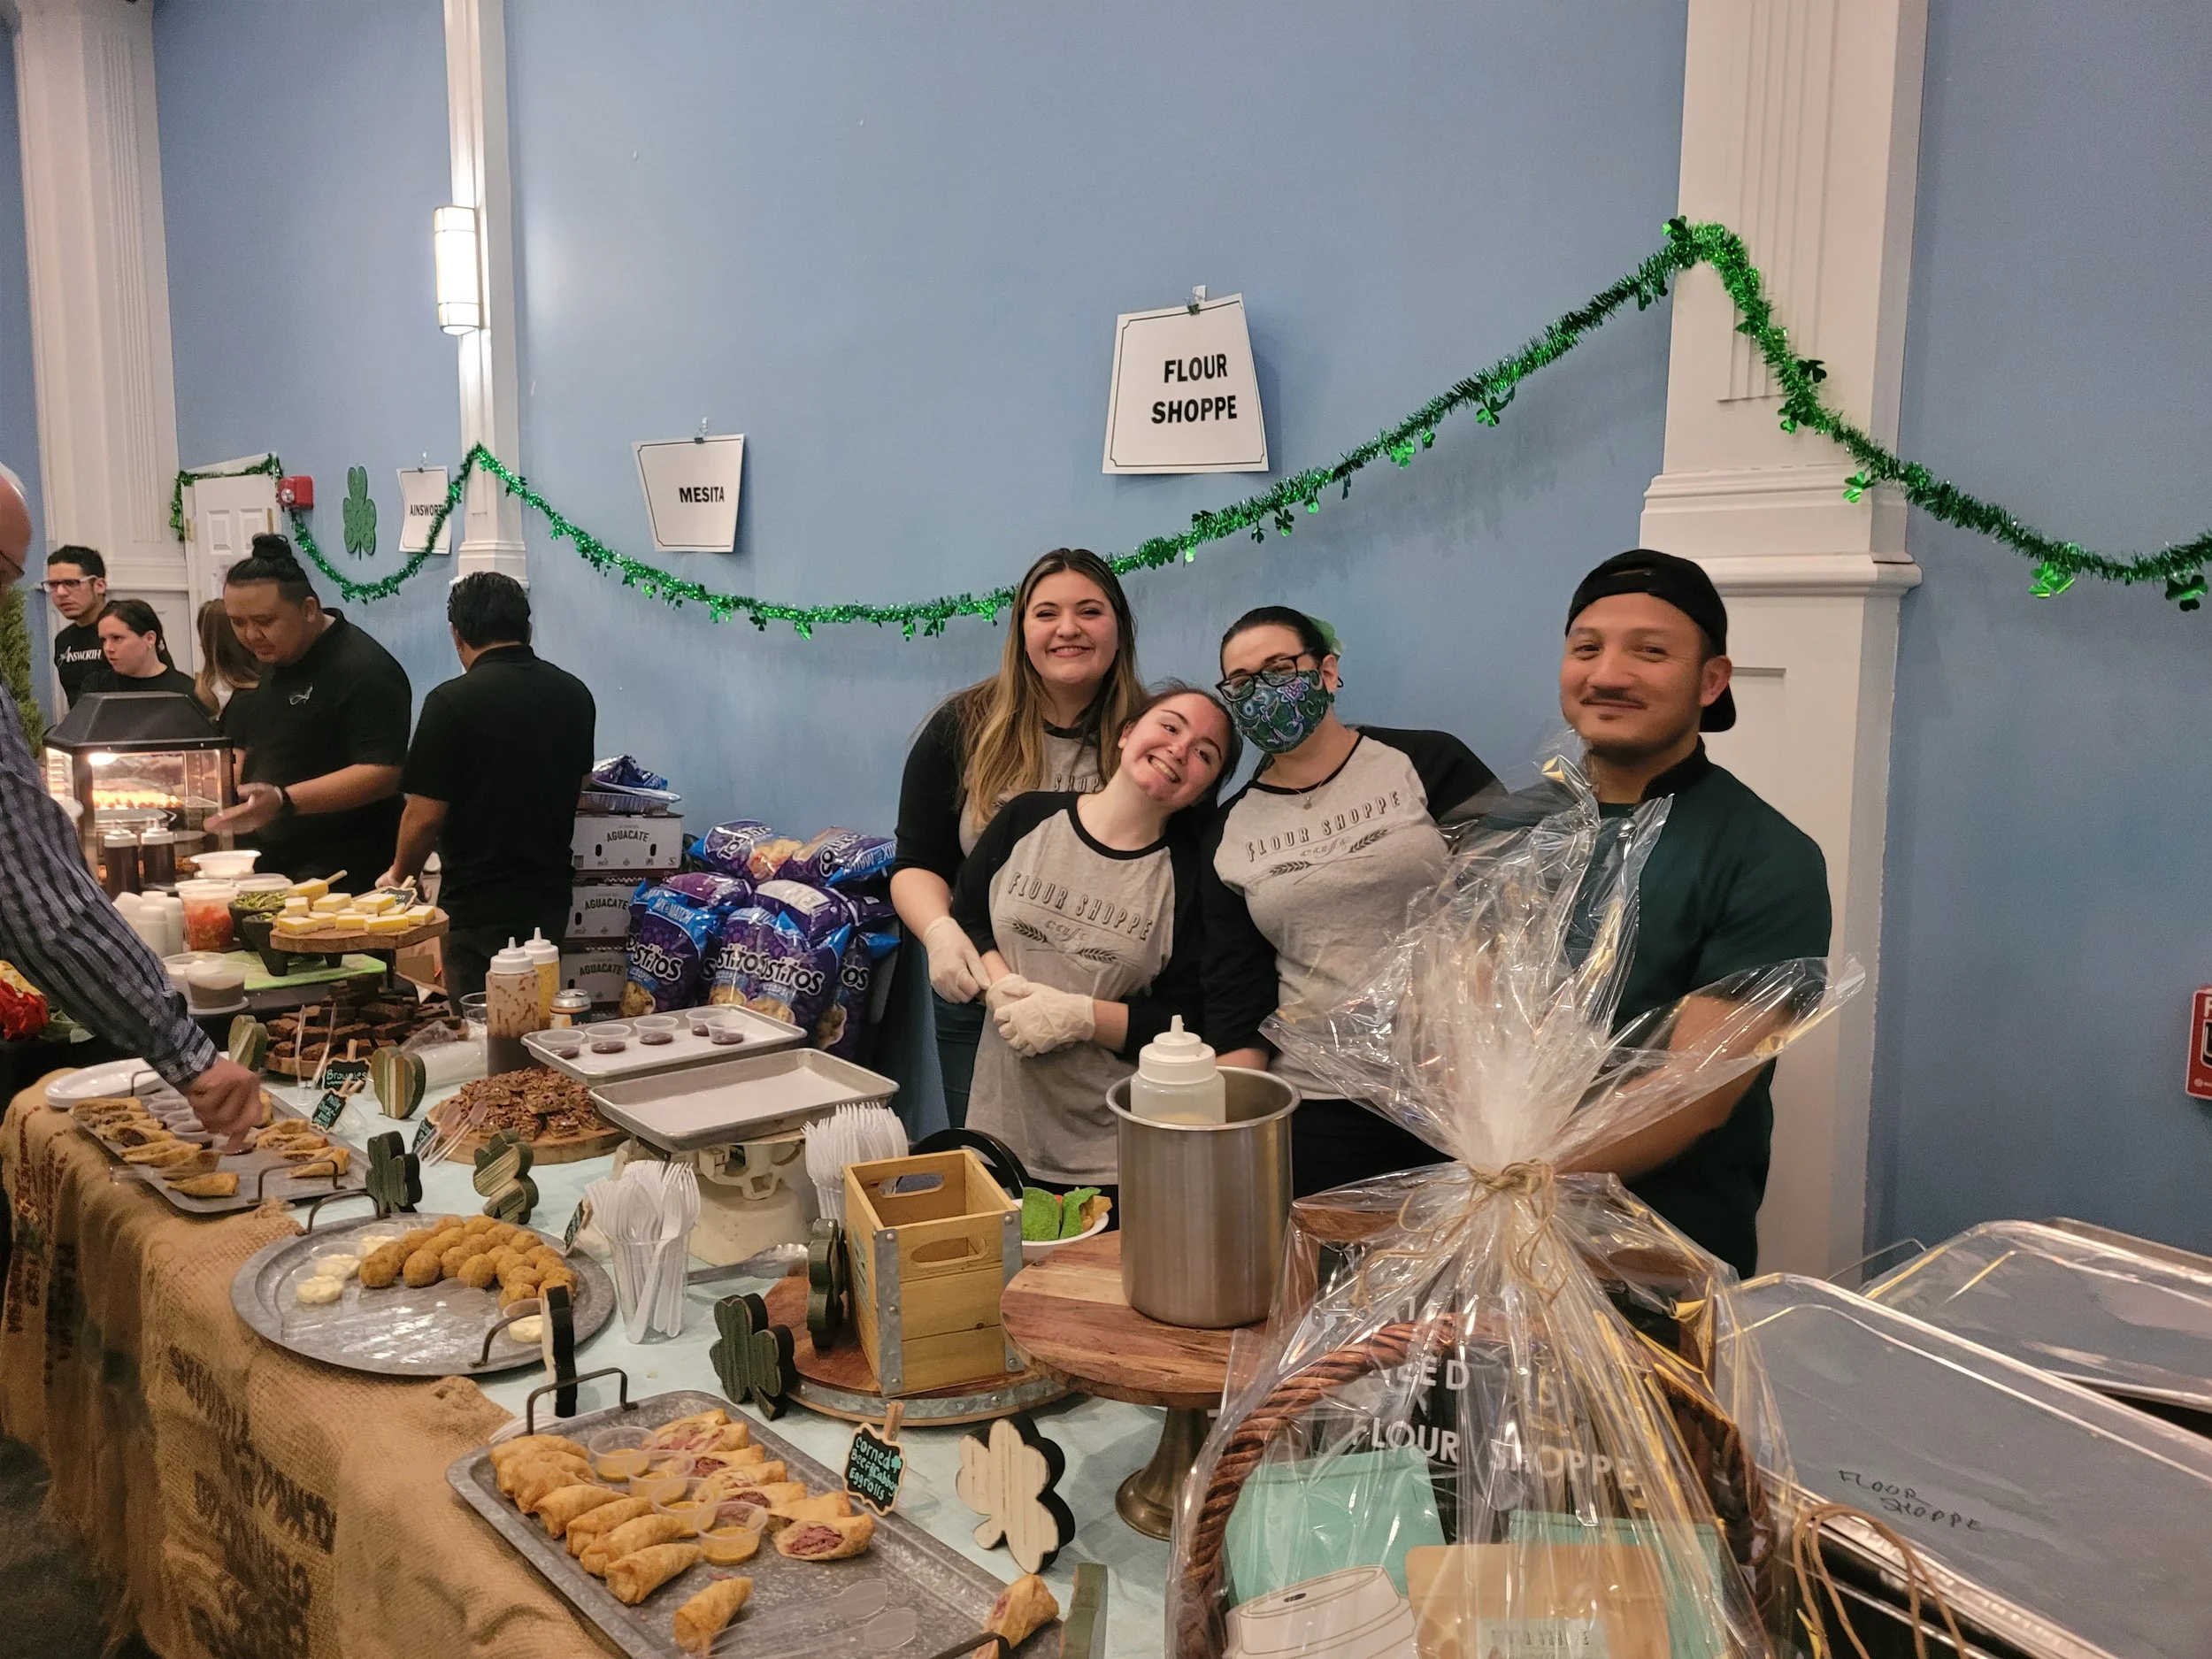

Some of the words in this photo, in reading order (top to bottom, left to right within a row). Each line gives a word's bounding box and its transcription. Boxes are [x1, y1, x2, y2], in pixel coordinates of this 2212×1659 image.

[1164, 353, 1227, 383] FLOUR
[1151, 395, 1237, 424] SHOPPE
[679, 486, 725, 503] MESITA
[410, 503, 445, 516] AINSWORT
[1053, 774, 1100, 792] SHOP
[607, 830, 649, 842] AGUACATE
[1245, 827, 1310, 863] FLOUR
[1321, 791, 1401, 835] SHOPPE
[585, 897, 628, 910] AGUACATE
[1008, 872, 1068, 910] FLOUR
[1076, 895, 1153, 941] SHOPPE
[580, 963, 624, 976] AGUACATE
[849, 1467, 885, 1501] Eggrolls
[1839, 1470, 1932, 1507] FLOUR
